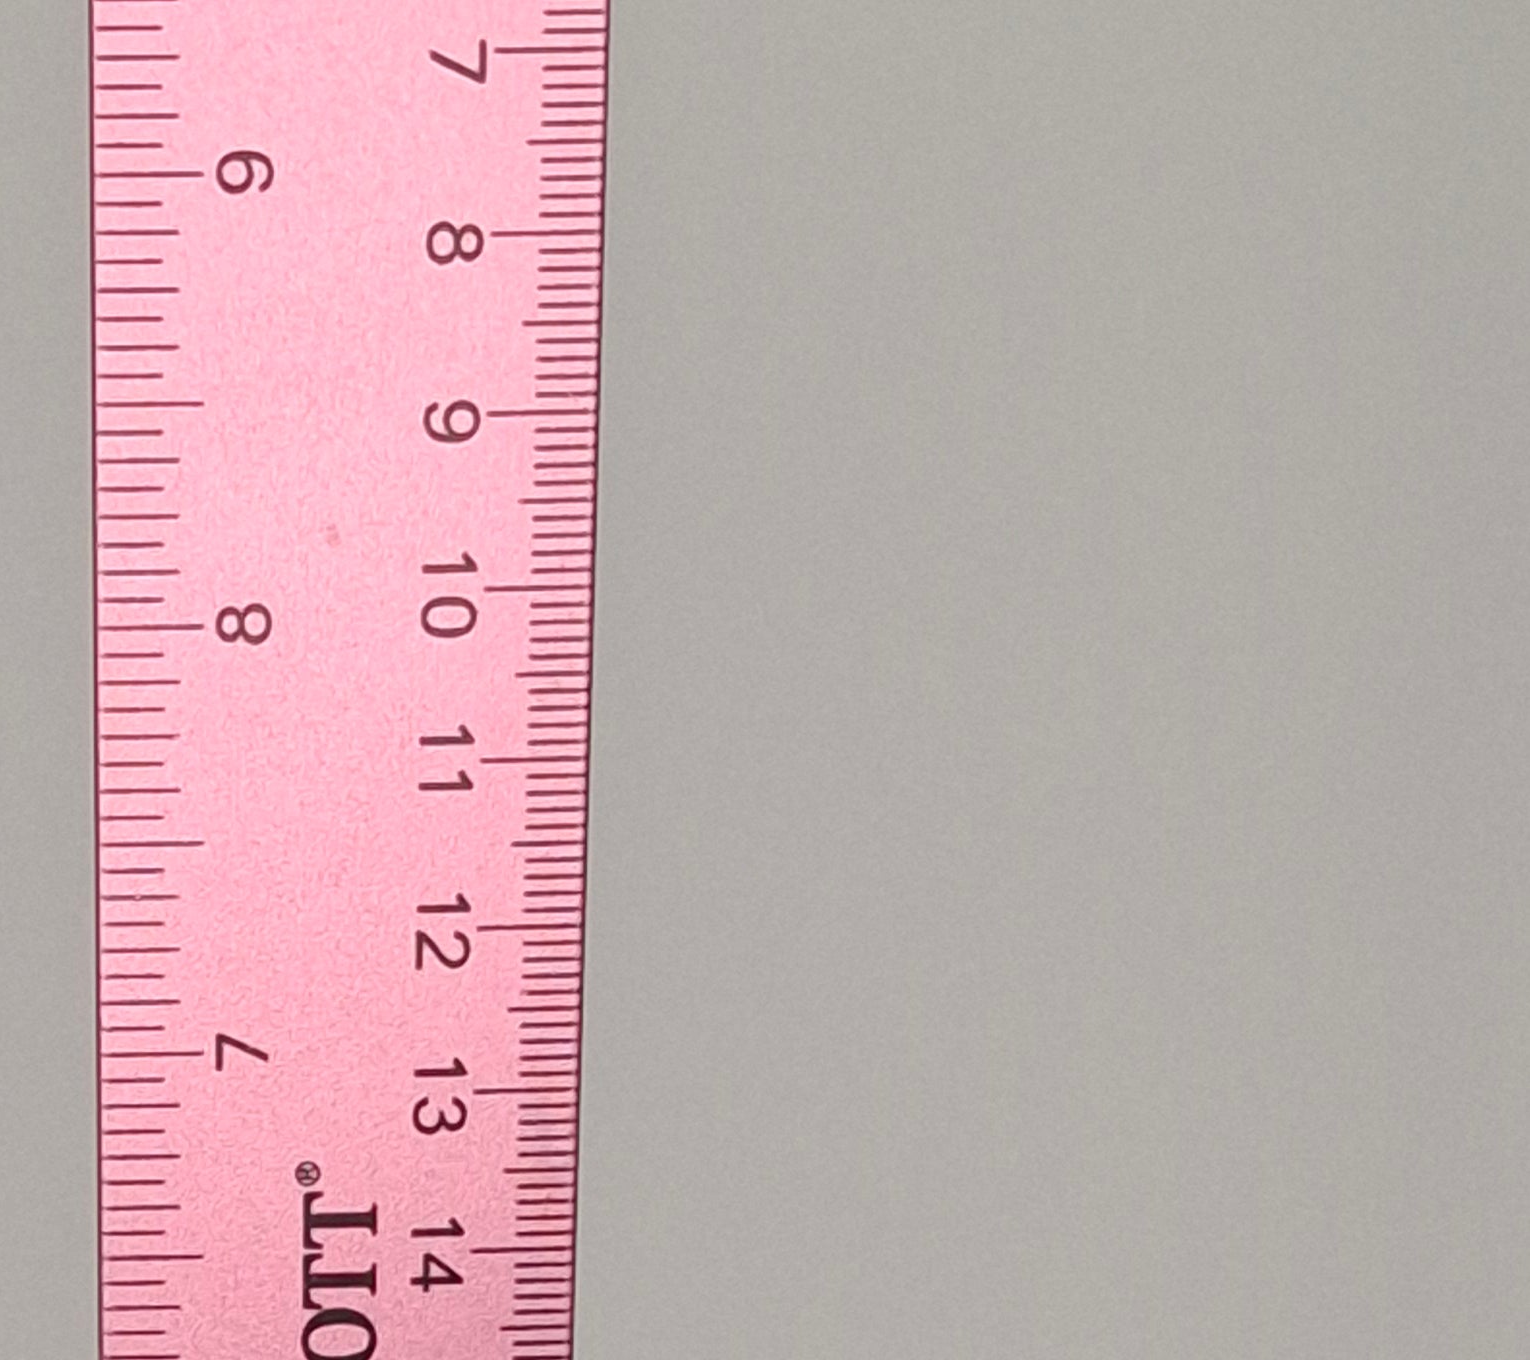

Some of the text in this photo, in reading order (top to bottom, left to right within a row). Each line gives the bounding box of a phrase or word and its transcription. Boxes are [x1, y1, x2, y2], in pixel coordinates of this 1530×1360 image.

[428, 38, 488, 85] 7
[215, 149, 275, 195] 9
[425, 220, 485, 266] 8
[422, 399, 482, 444] 9
[420, 551, 479, 639] 10
[214, 602, 273, 646] 8
[417, 724, 476, 792] 11
[414, 892, 472, 972] 12
[214, 1032, 270, 1072] 7
[411, 1056, 469, 1136] 13
[409, 1216, 466, 1294] 14
